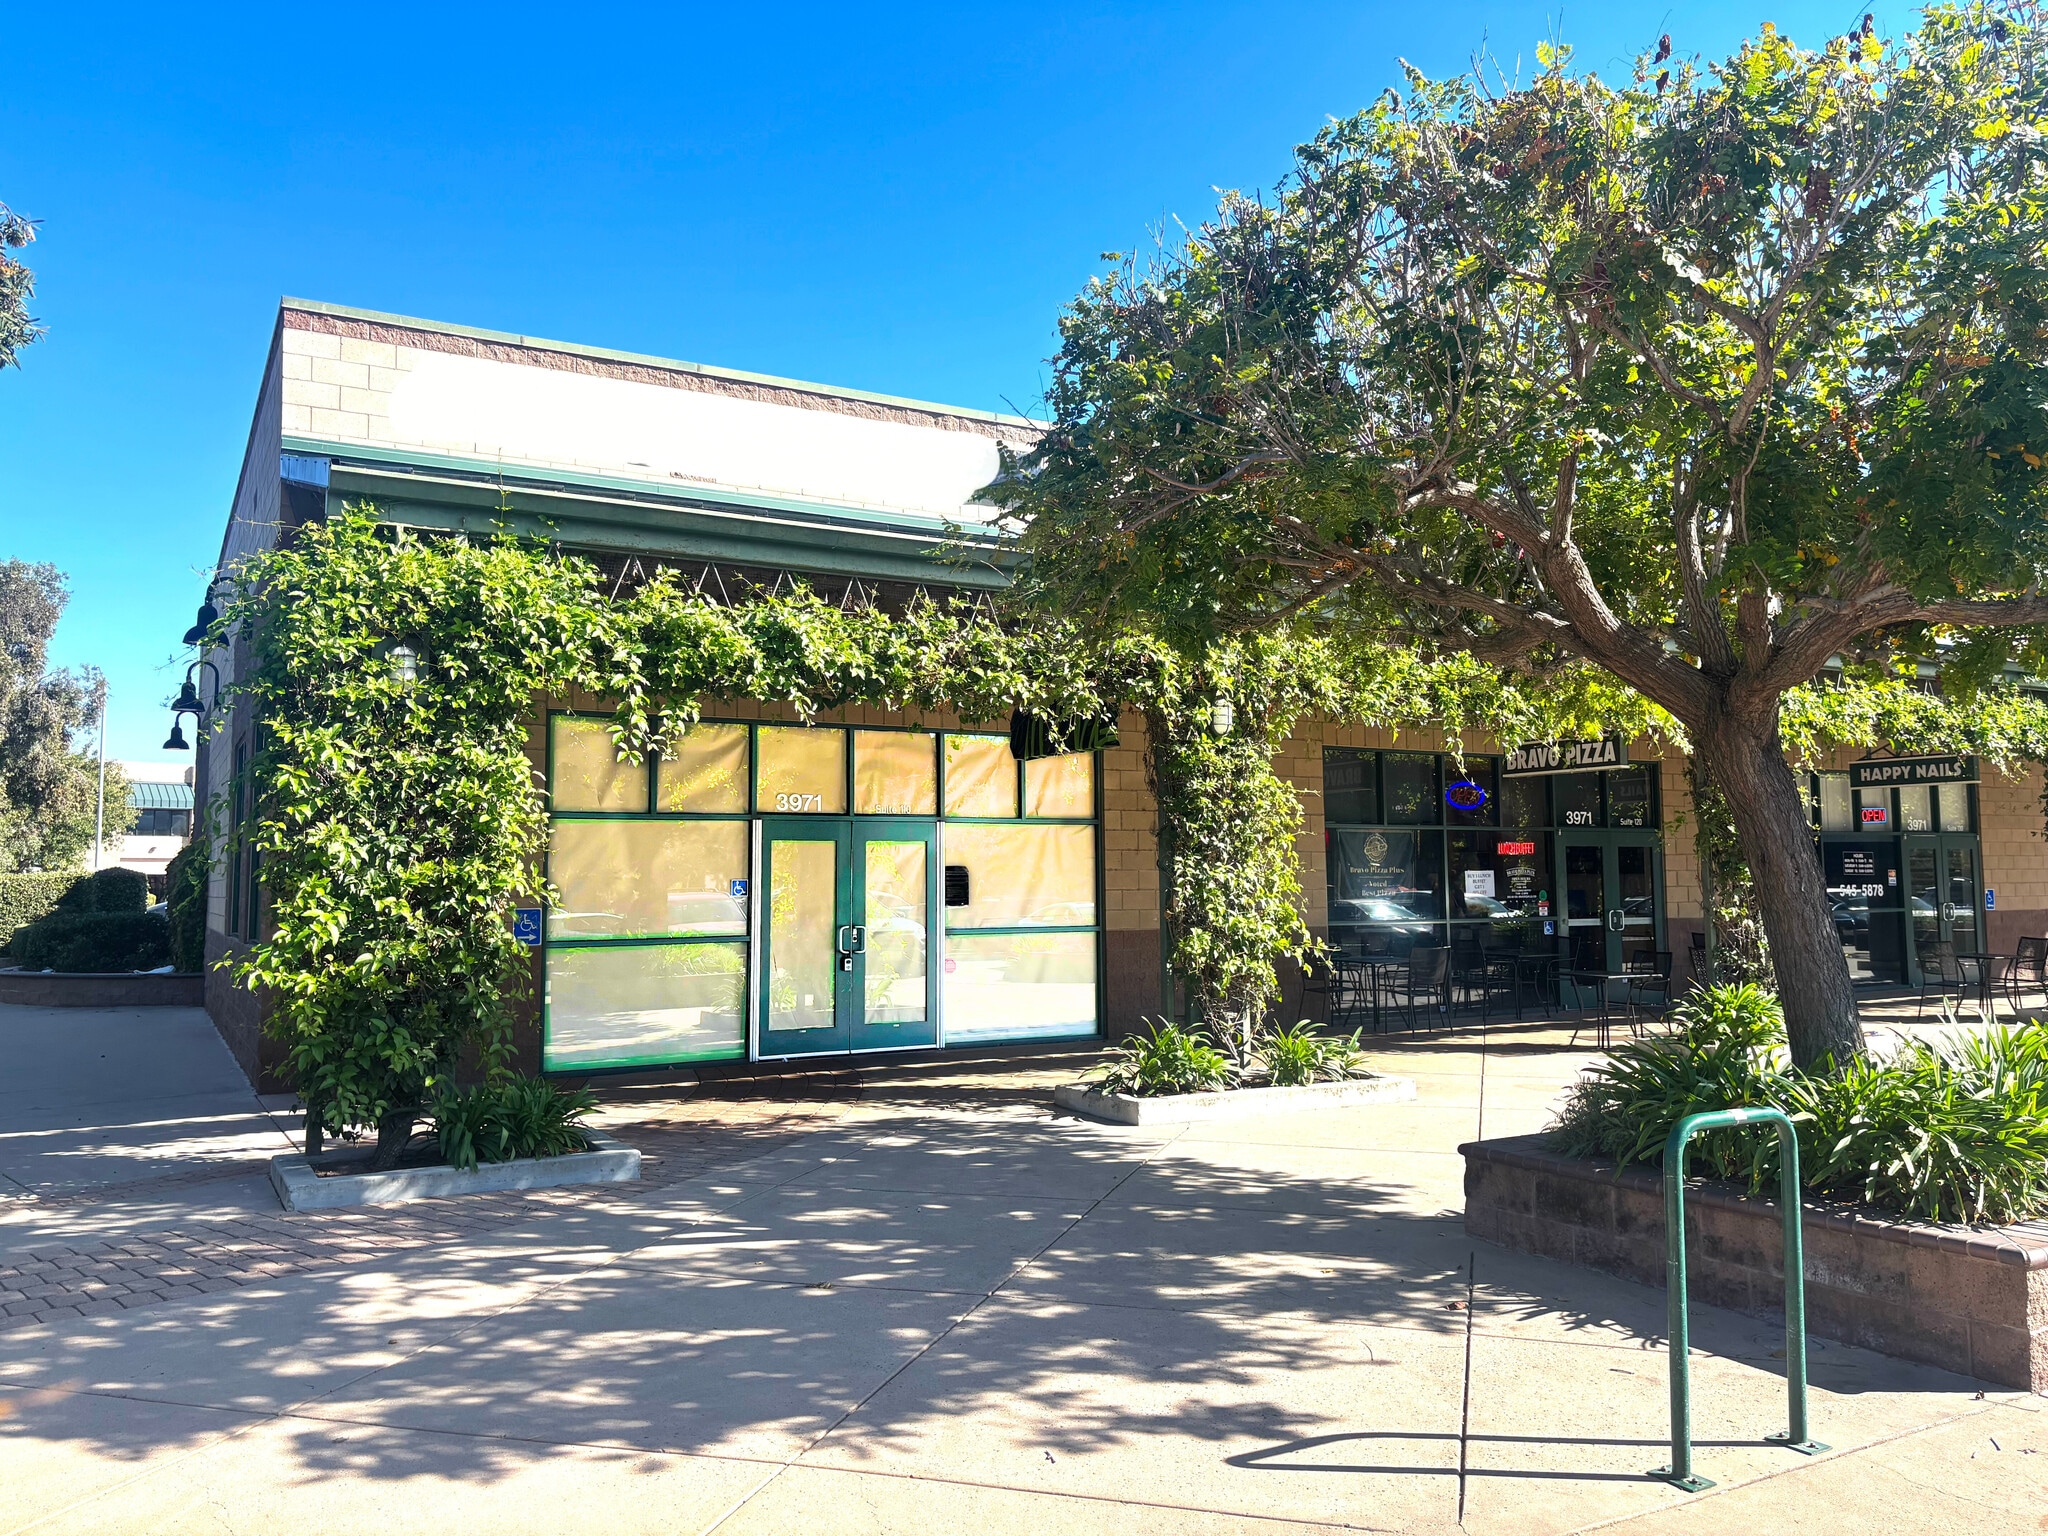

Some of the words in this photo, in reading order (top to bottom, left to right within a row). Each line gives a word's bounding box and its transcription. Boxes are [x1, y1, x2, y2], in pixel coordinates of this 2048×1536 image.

[1507, 747, 1559, 771] BRAVO
[1566, 741, 1617, 765] PIZZA
[1860, 765, 1911, 781] HAPPY
[1916, 762, 1962, 778] NAILS
[776, 793, 822, 812] 3971
[875, 804, 897, 814] Suite
[1565, 811, 1592, 825] 3971
[1620, 818, 1633, 826] Suite
[1861, 809, 1885, 822] OPEN
[1907, 819, 1927, 831] 3971
[1389, 865, 1405, 873] Plus
